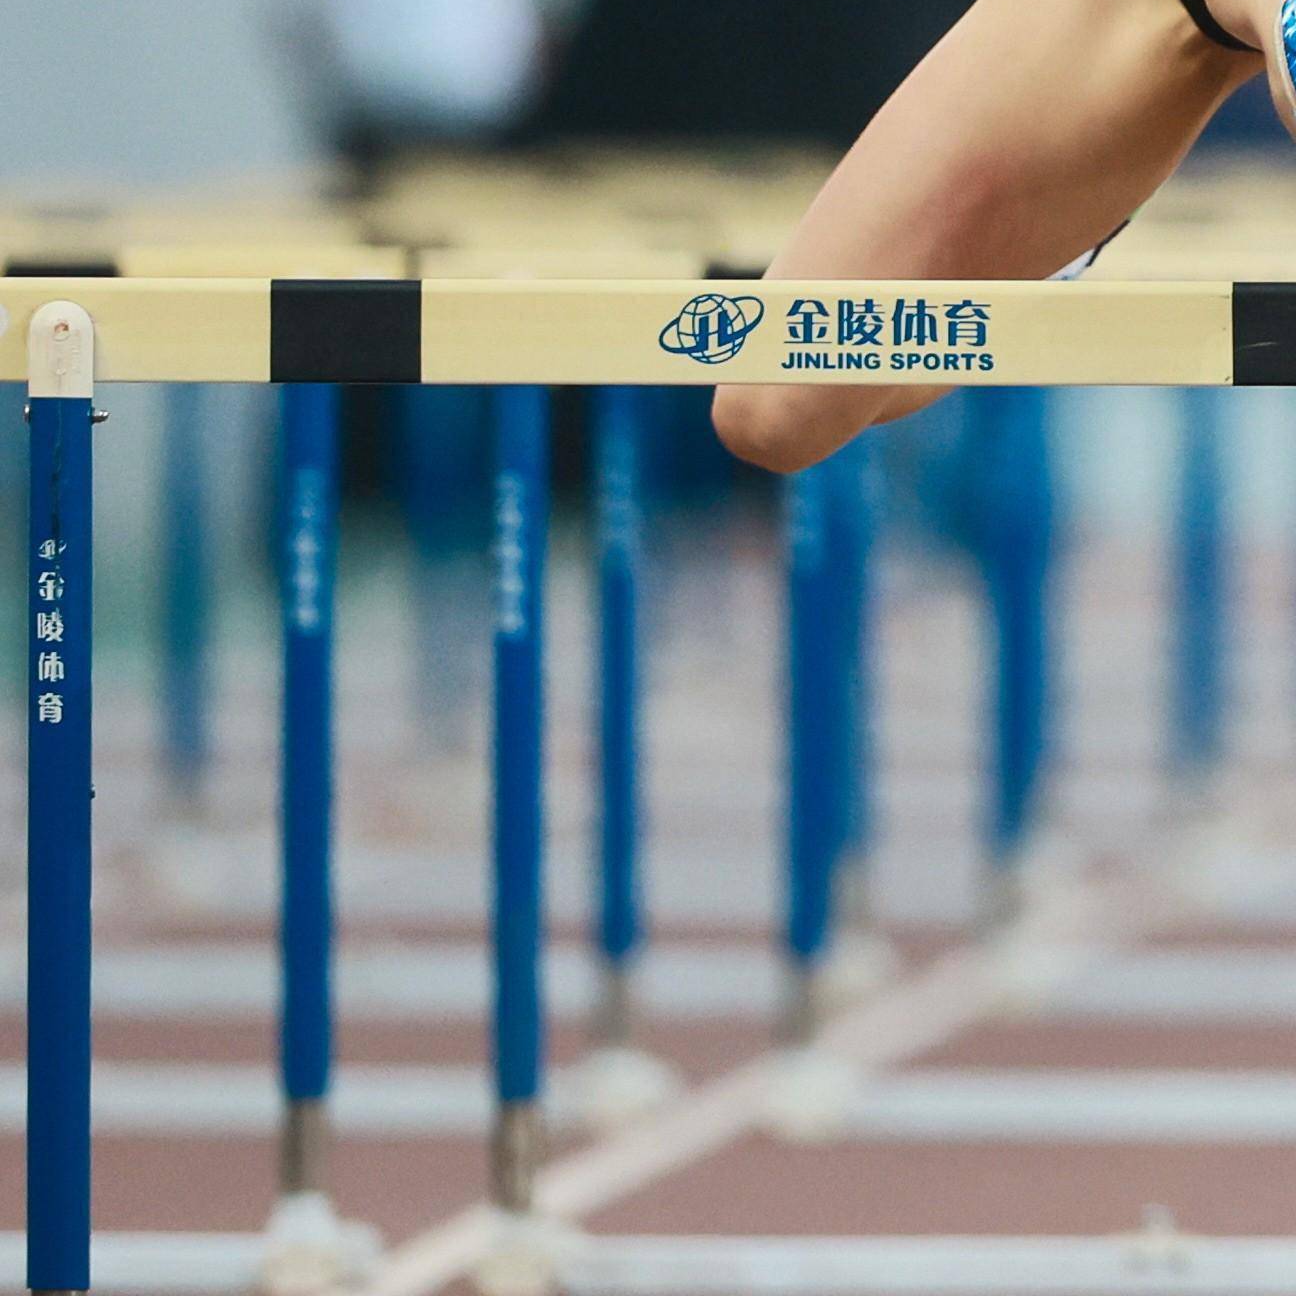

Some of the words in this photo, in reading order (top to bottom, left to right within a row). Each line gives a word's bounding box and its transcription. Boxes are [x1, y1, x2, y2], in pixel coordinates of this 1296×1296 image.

[782, 298, 993, 347] 金陵体育
[781, 352, 881, 371] JINLING
[890, 351, 994, 371] SPORTS
[37, 570, 65, 724] 金陵体育
